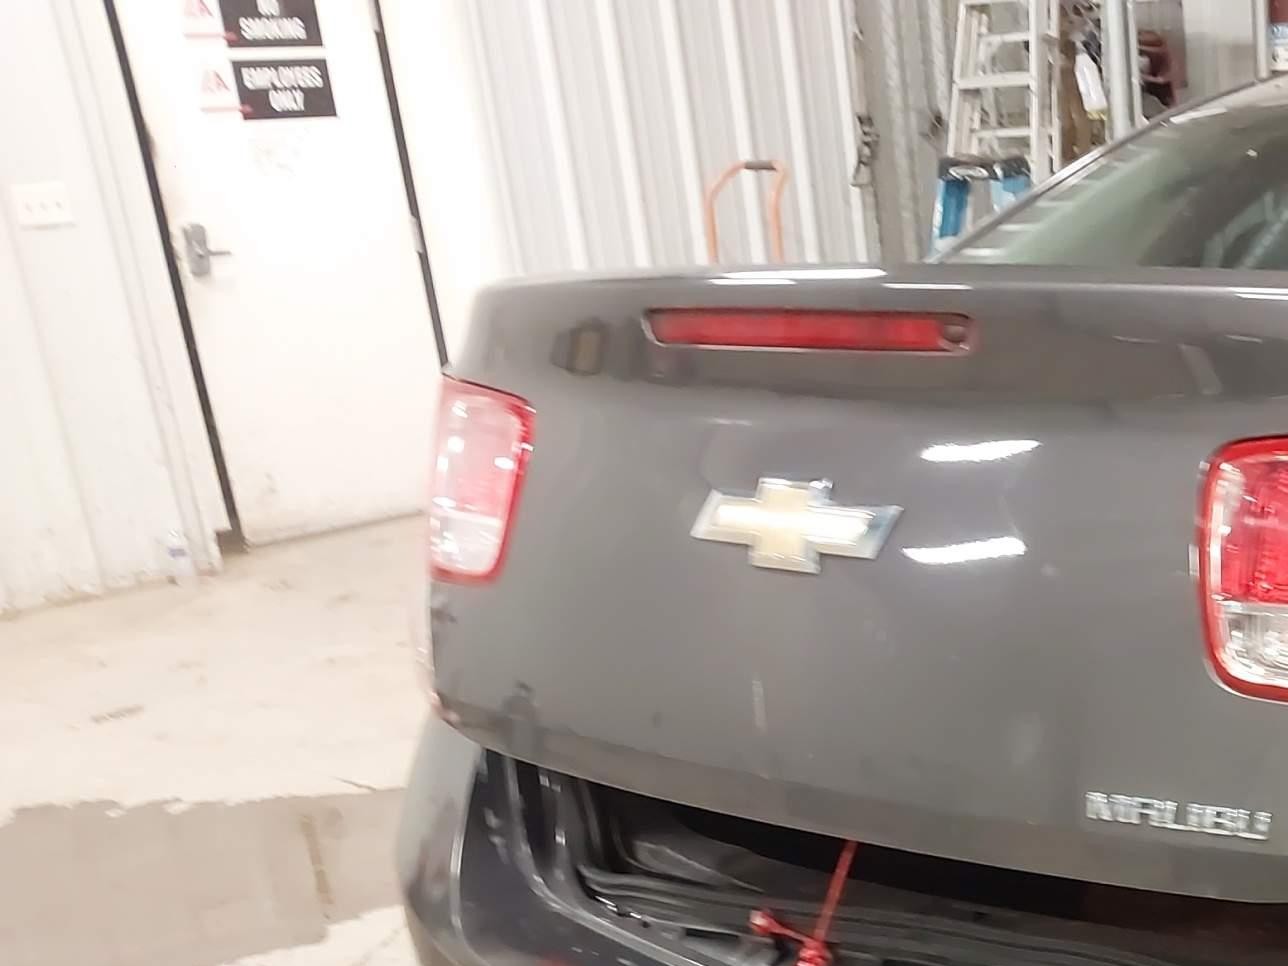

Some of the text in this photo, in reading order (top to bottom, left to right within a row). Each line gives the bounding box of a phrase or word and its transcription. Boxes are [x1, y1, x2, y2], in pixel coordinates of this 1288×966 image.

[239, 17, 307, 40] SMOKING
[241, 66, 324, 90] EMPLOYEES
[268, 89, 305, 112] ONLY
[1084, 791, 1273, 841] MALIBU
